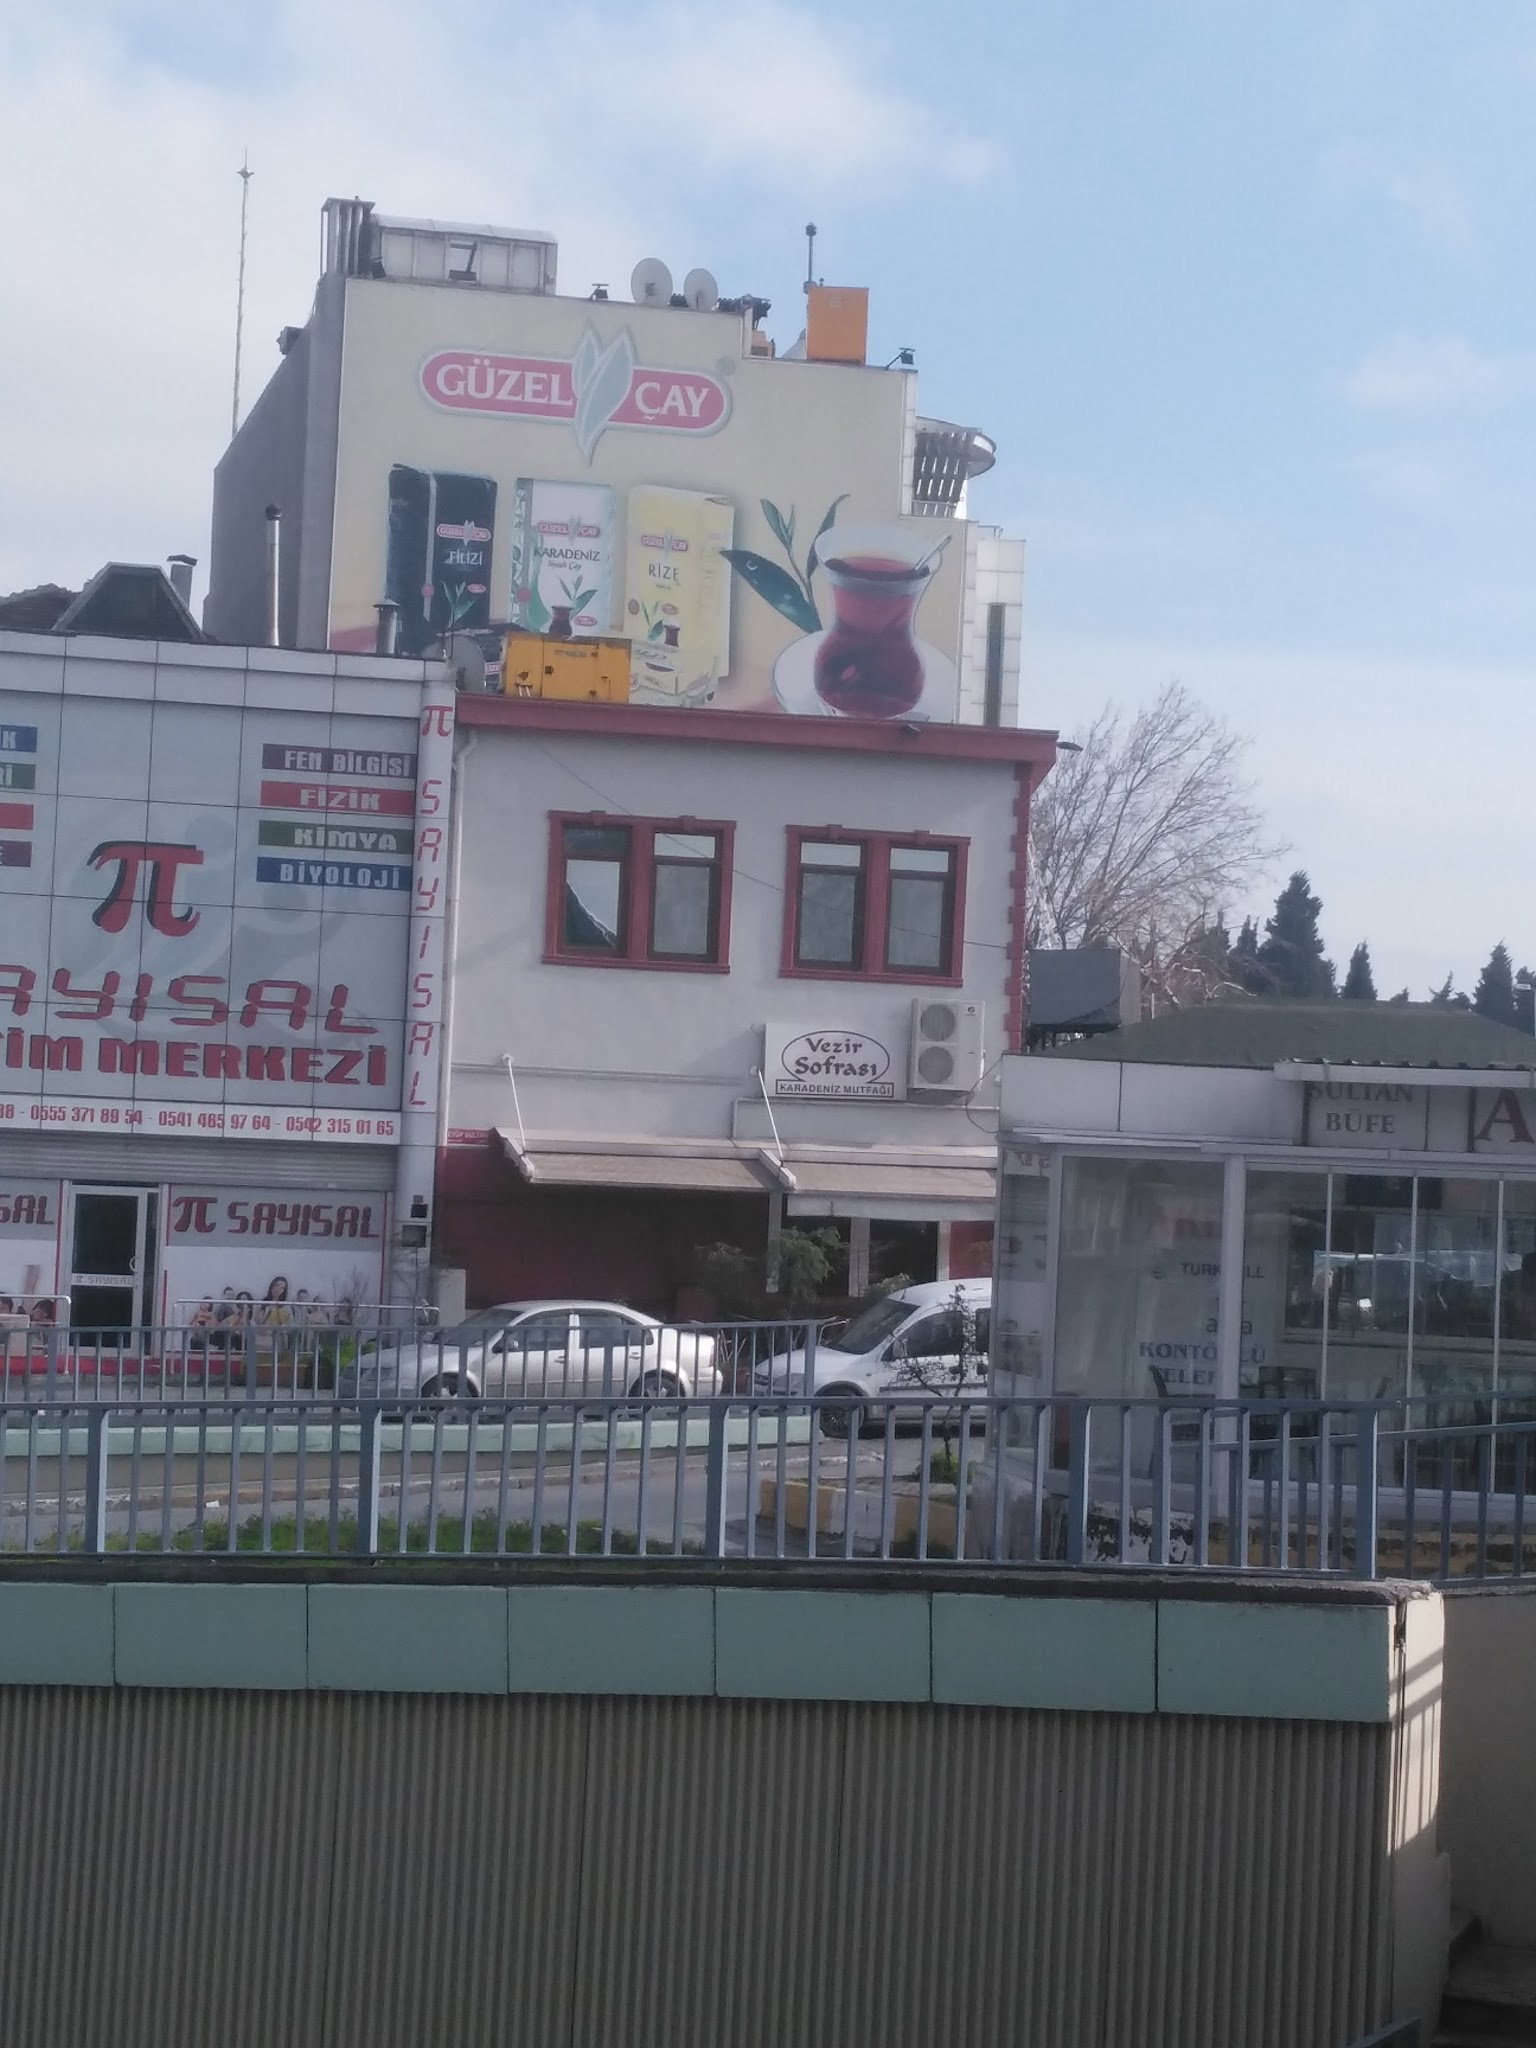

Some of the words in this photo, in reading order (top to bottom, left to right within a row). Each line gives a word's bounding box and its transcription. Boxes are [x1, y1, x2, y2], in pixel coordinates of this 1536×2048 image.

[436, 358, 573, 406] GÜZEL
[635, 382, 710, 420] ÇAY
[535, 548, 600, 562] KARADENİZ
[284, 750, 322, 771] FEN
[333, 751, 410, 777] BİLGİSİ
[300, 787, 380, 811] FİZİK
[294, 826, 398, 851] KİMYA
[280, 861, 400, 889] BİYOLOJİ
[805, 1037, 863, 1053] Vezir
[98, 1037, 388, 1086] MERKEZİ
[794, 1055, 877, 1077] Sofrası
[780, 1082, 841, 1094] KARADENİZ
[843, 1085, 891, 1095] MUTFAĞI
[31, 1104, 67, 1121] 0555
[71, 1106, 95, 1123] 371
[100, 1108, 120, 1124] 89
[125, 1109, 142, 1125] 54
[158, 1111, 192, 1128] 0541
[230, 1114, 247, 1130] 97
[252, 1115, 271, 1131] 64
[286, 1116, 322, 1133] 0542
[327, 1118, 351, 1134] 315
[356, 1119, 371, 1135] 01
[376, 1120, 394, 1136] 65
[1326, 1109, 1395, 1133] BÜFE
[227, 1200, 380, 1239] SAYISAL
[1182, 1263, 1264, 1278] TURKLL
